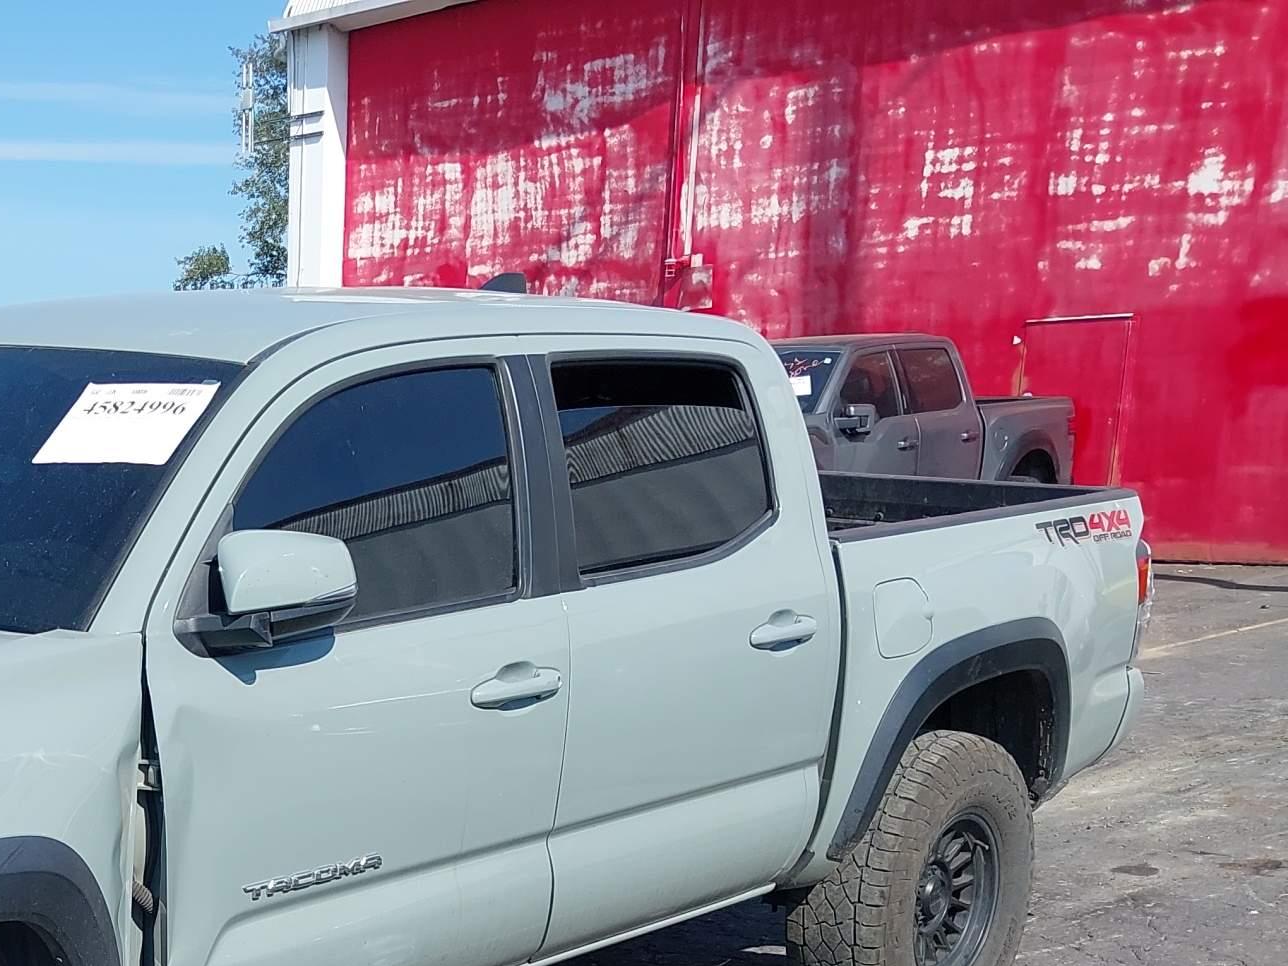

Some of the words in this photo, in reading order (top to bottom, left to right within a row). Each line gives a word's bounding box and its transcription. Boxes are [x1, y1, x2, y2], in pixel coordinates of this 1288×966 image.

[83, 400, 186, 415] 45824996
[1093, 534, 1109, 543] OFF
[1111, 530, 1132, 540] ROAD
[242, 852, 383, 901] TACOMA
